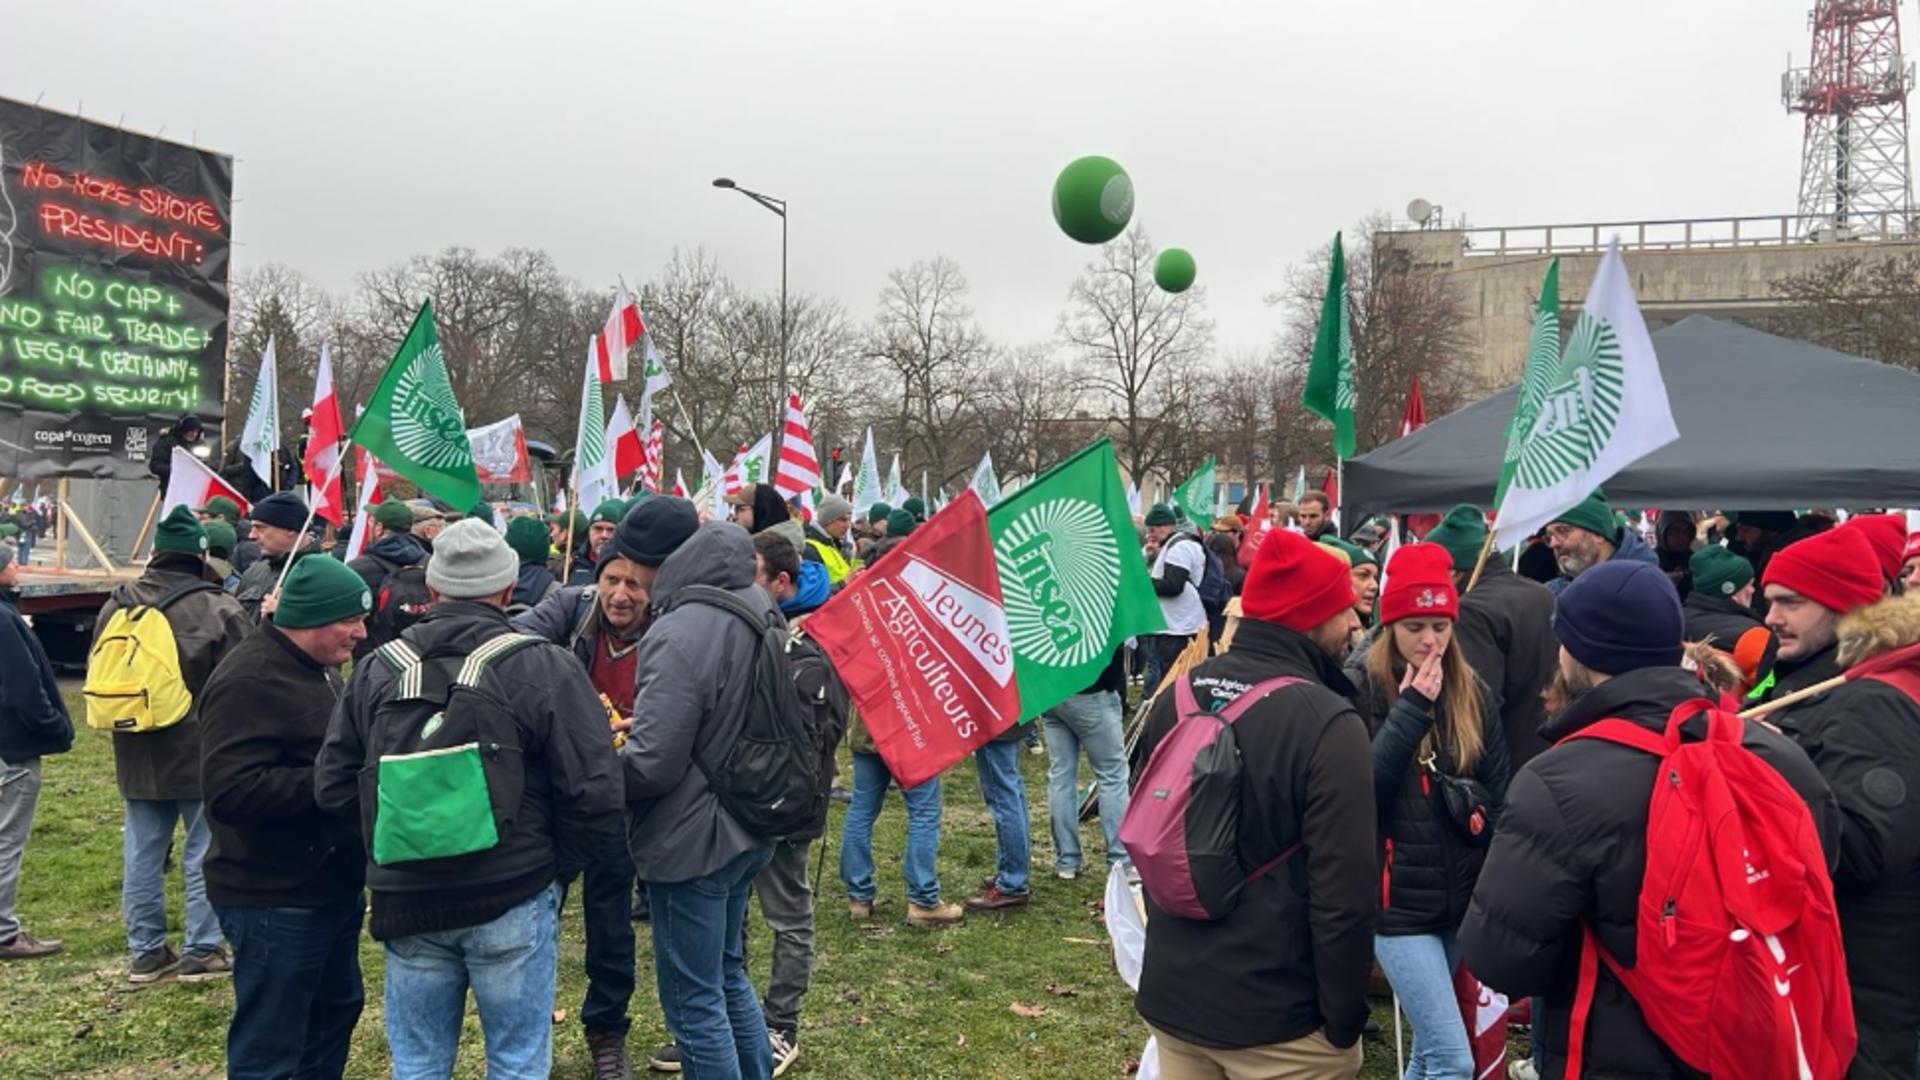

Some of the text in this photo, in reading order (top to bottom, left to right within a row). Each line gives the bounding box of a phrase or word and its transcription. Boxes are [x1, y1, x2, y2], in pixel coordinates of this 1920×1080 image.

[23, 164, 62, 189] NO
[40, 203, 203, 263] PRESIDENT:
[55, 272, 95, 299] NO
[0, 303, 41, 328] NO
[56, 310, 113, 339] FAIR
[14, 337, 94, 369] LEGAL
[19, 377, 86, 401] FOOD
[34, 430, 65, 443] copa
[72, 432, 112, 446] cogeca
[922, 580, 1010, 666] Jeunes
[881, 595, 979, 739] Agriculteurs
